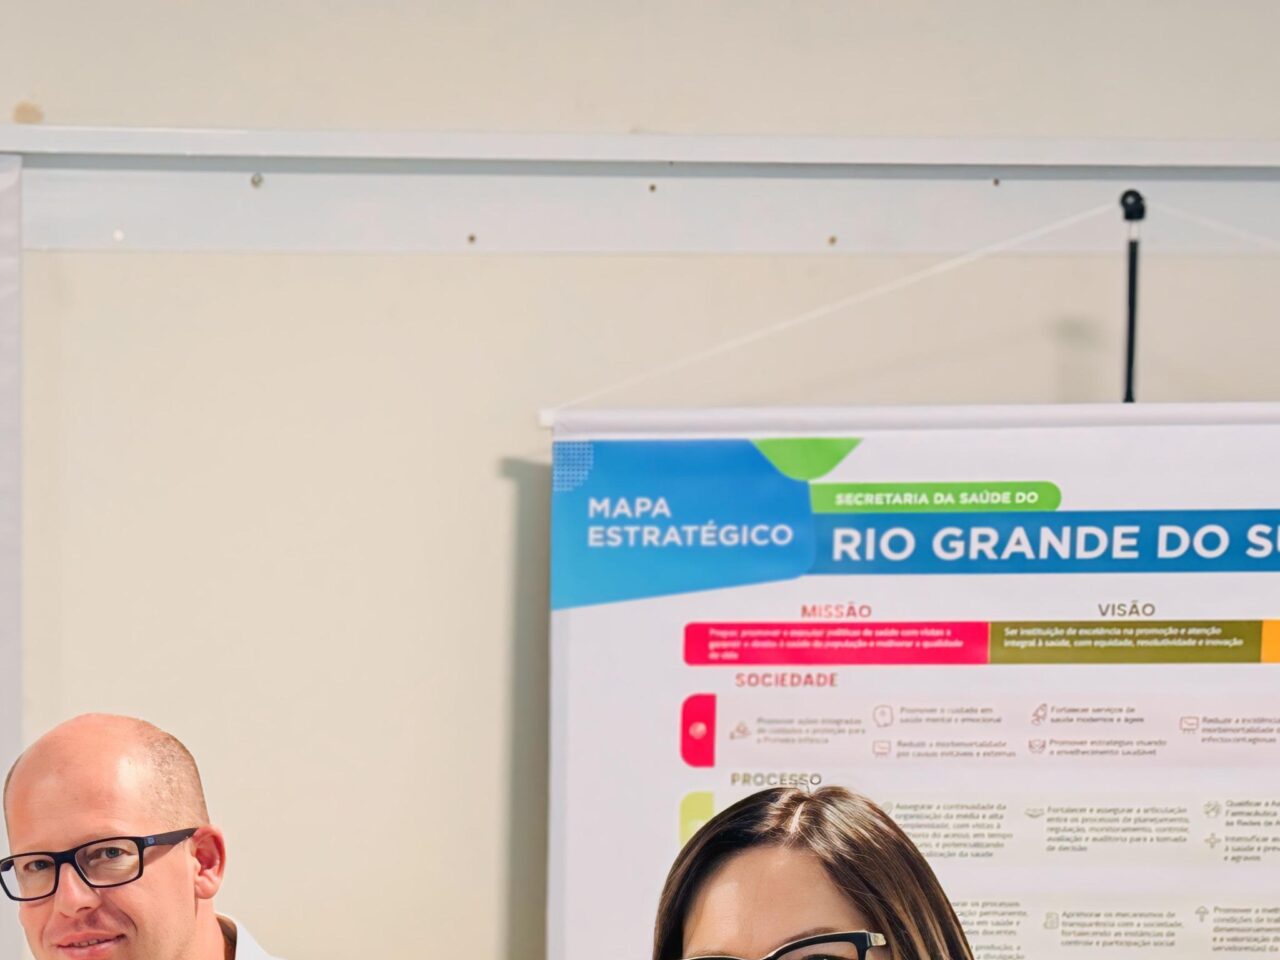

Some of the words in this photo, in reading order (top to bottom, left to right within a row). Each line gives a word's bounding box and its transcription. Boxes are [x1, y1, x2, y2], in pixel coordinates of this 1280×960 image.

[835, 493, 928, 506] SECRETARIA
[933, 493, 955, 504] DA
[959, 489, 1012, 504] SAÚDE
[1016, 492, 1039, 504] DO
[588, 498, 671, 519] MAPA
[587, 520, 793, 547] ESTRATÉGICO
[832, 526, 916, 561] RIO
[932, 526, 1140, 561] GRANDE
[1157, 524, 1229, 559] DO
[801, 602, 872, 618] MISSÃO
[1098, 600, 1156, 617] VISÃO
[735, 673, 837, 687] SOCIEDADE
[730, 773, 822, 786] PROCESSO
